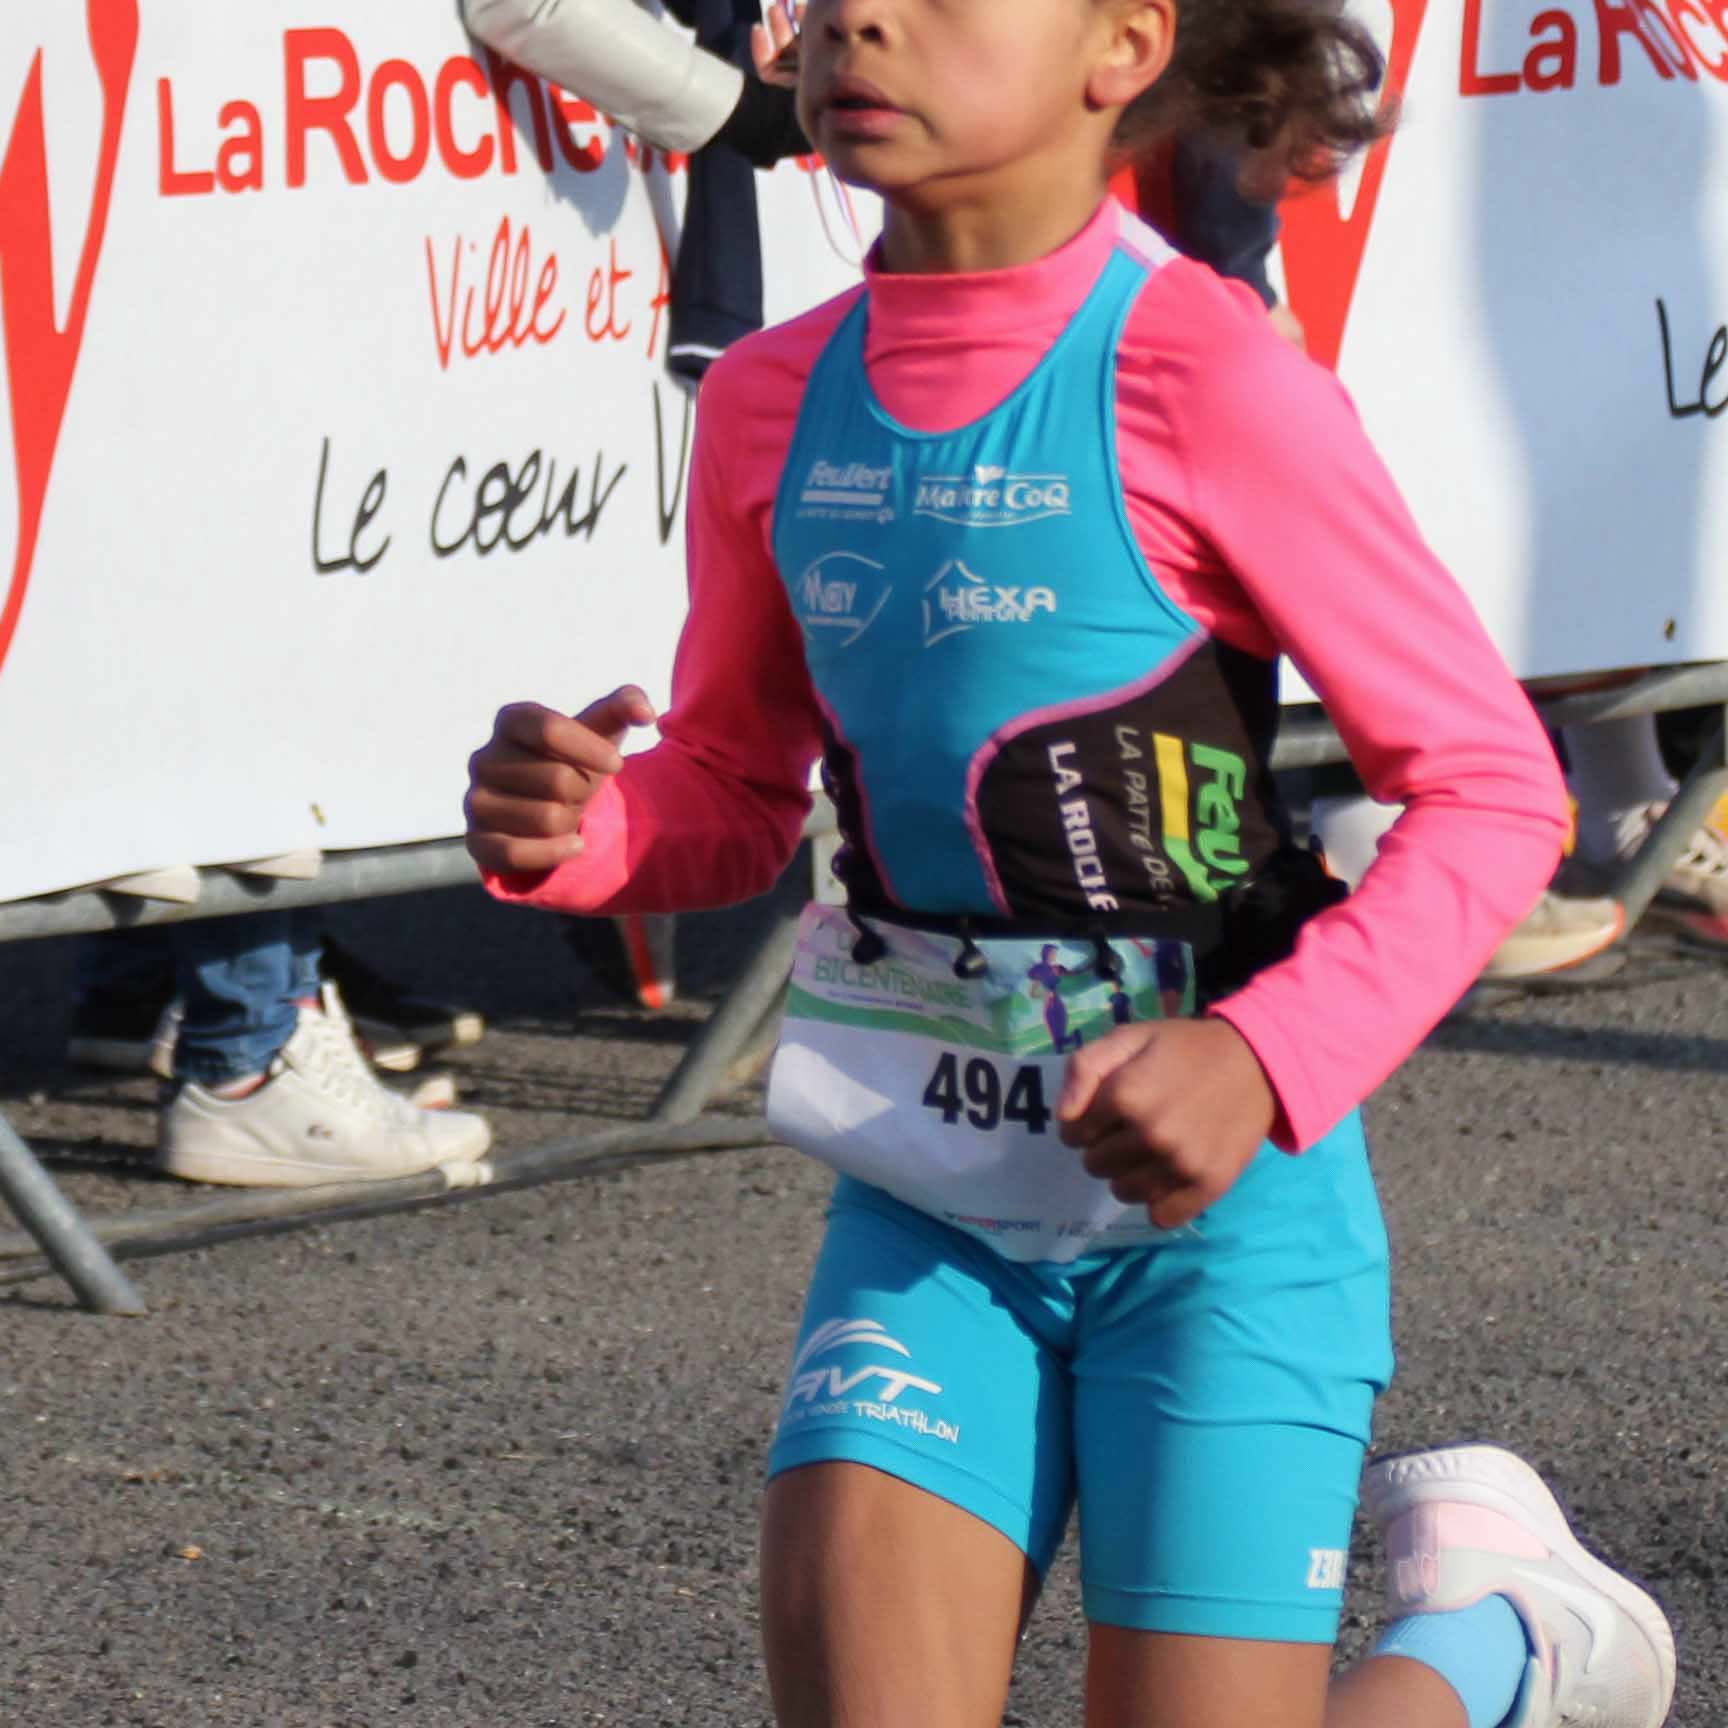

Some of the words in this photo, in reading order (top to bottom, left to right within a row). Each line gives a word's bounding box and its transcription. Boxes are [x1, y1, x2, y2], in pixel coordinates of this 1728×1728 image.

[159, 76, 264, 196] La
[424, 214, 568, 371] Ville
[585, 236, 633, 342] et
[312, 436, 391, 576] Le
[1047, 740, 1083, 796] LA
[1115, 724, 1143, 761] LA
[1124, 769, 1155, 853] PATTE
[922, 1051, 1052, 1135] 494
[852, 1400, 961, 1445] TRIATHLON
